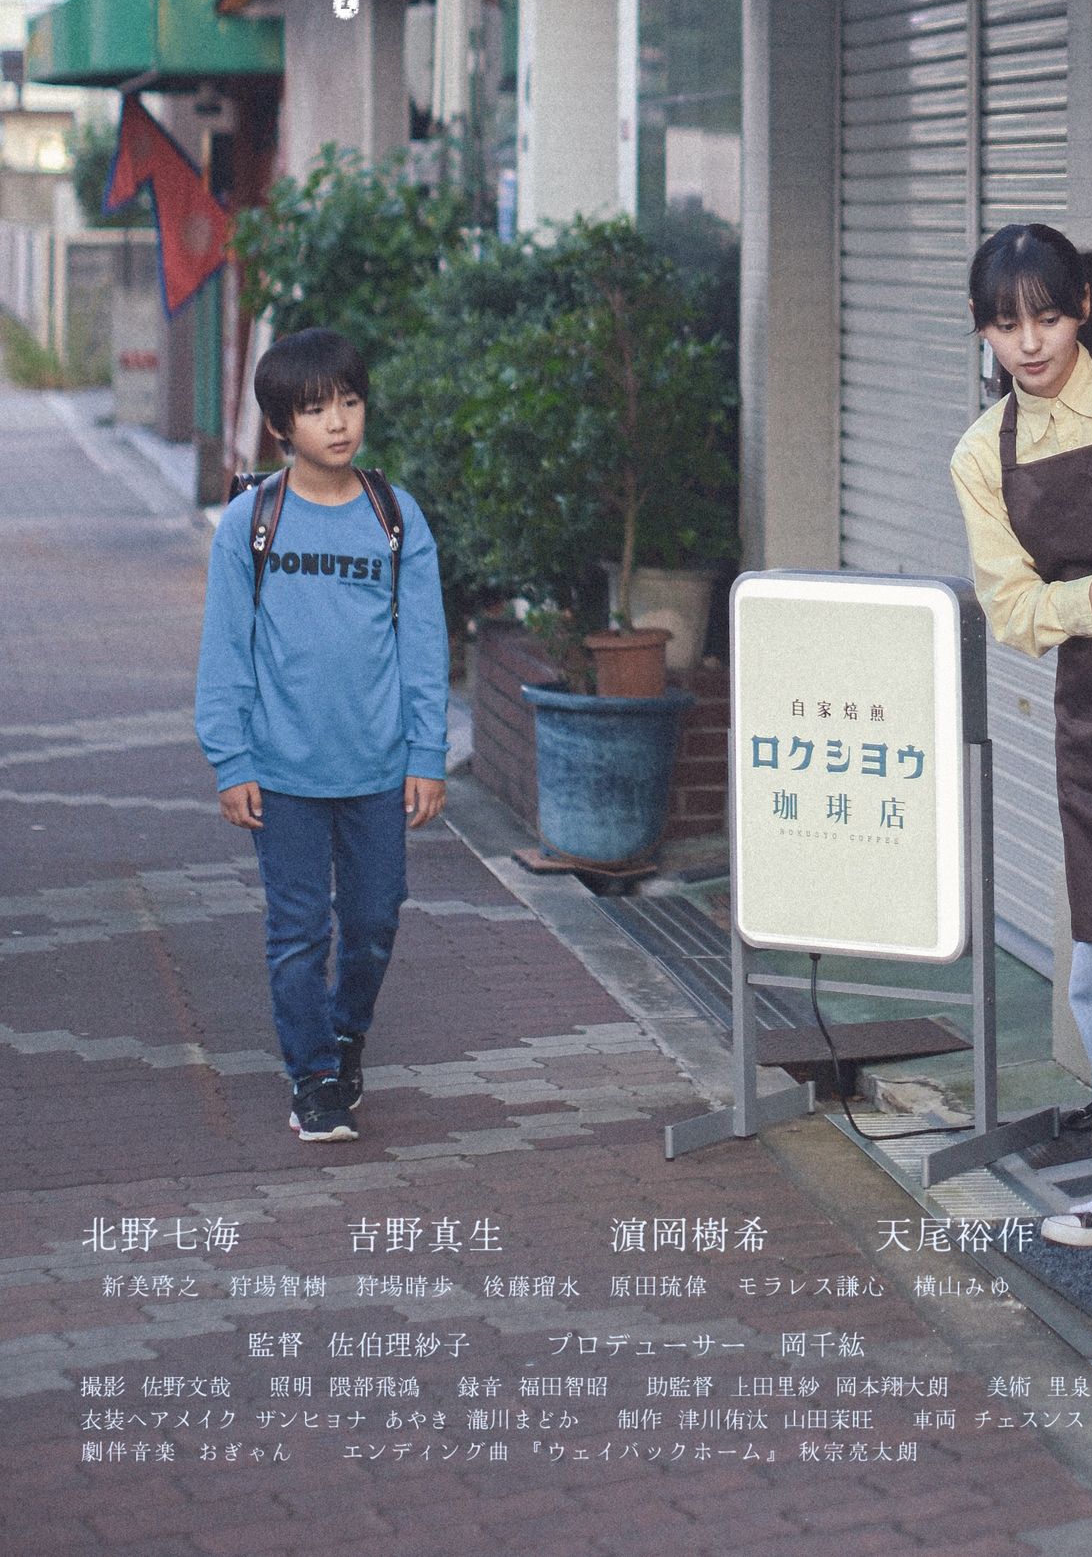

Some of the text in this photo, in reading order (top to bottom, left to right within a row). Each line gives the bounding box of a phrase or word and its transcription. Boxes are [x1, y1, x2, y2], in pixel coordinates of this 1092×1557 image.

[791, 698, 886, 723] 自家焙煎
[772, 788, 906, 830] 珈琲店
